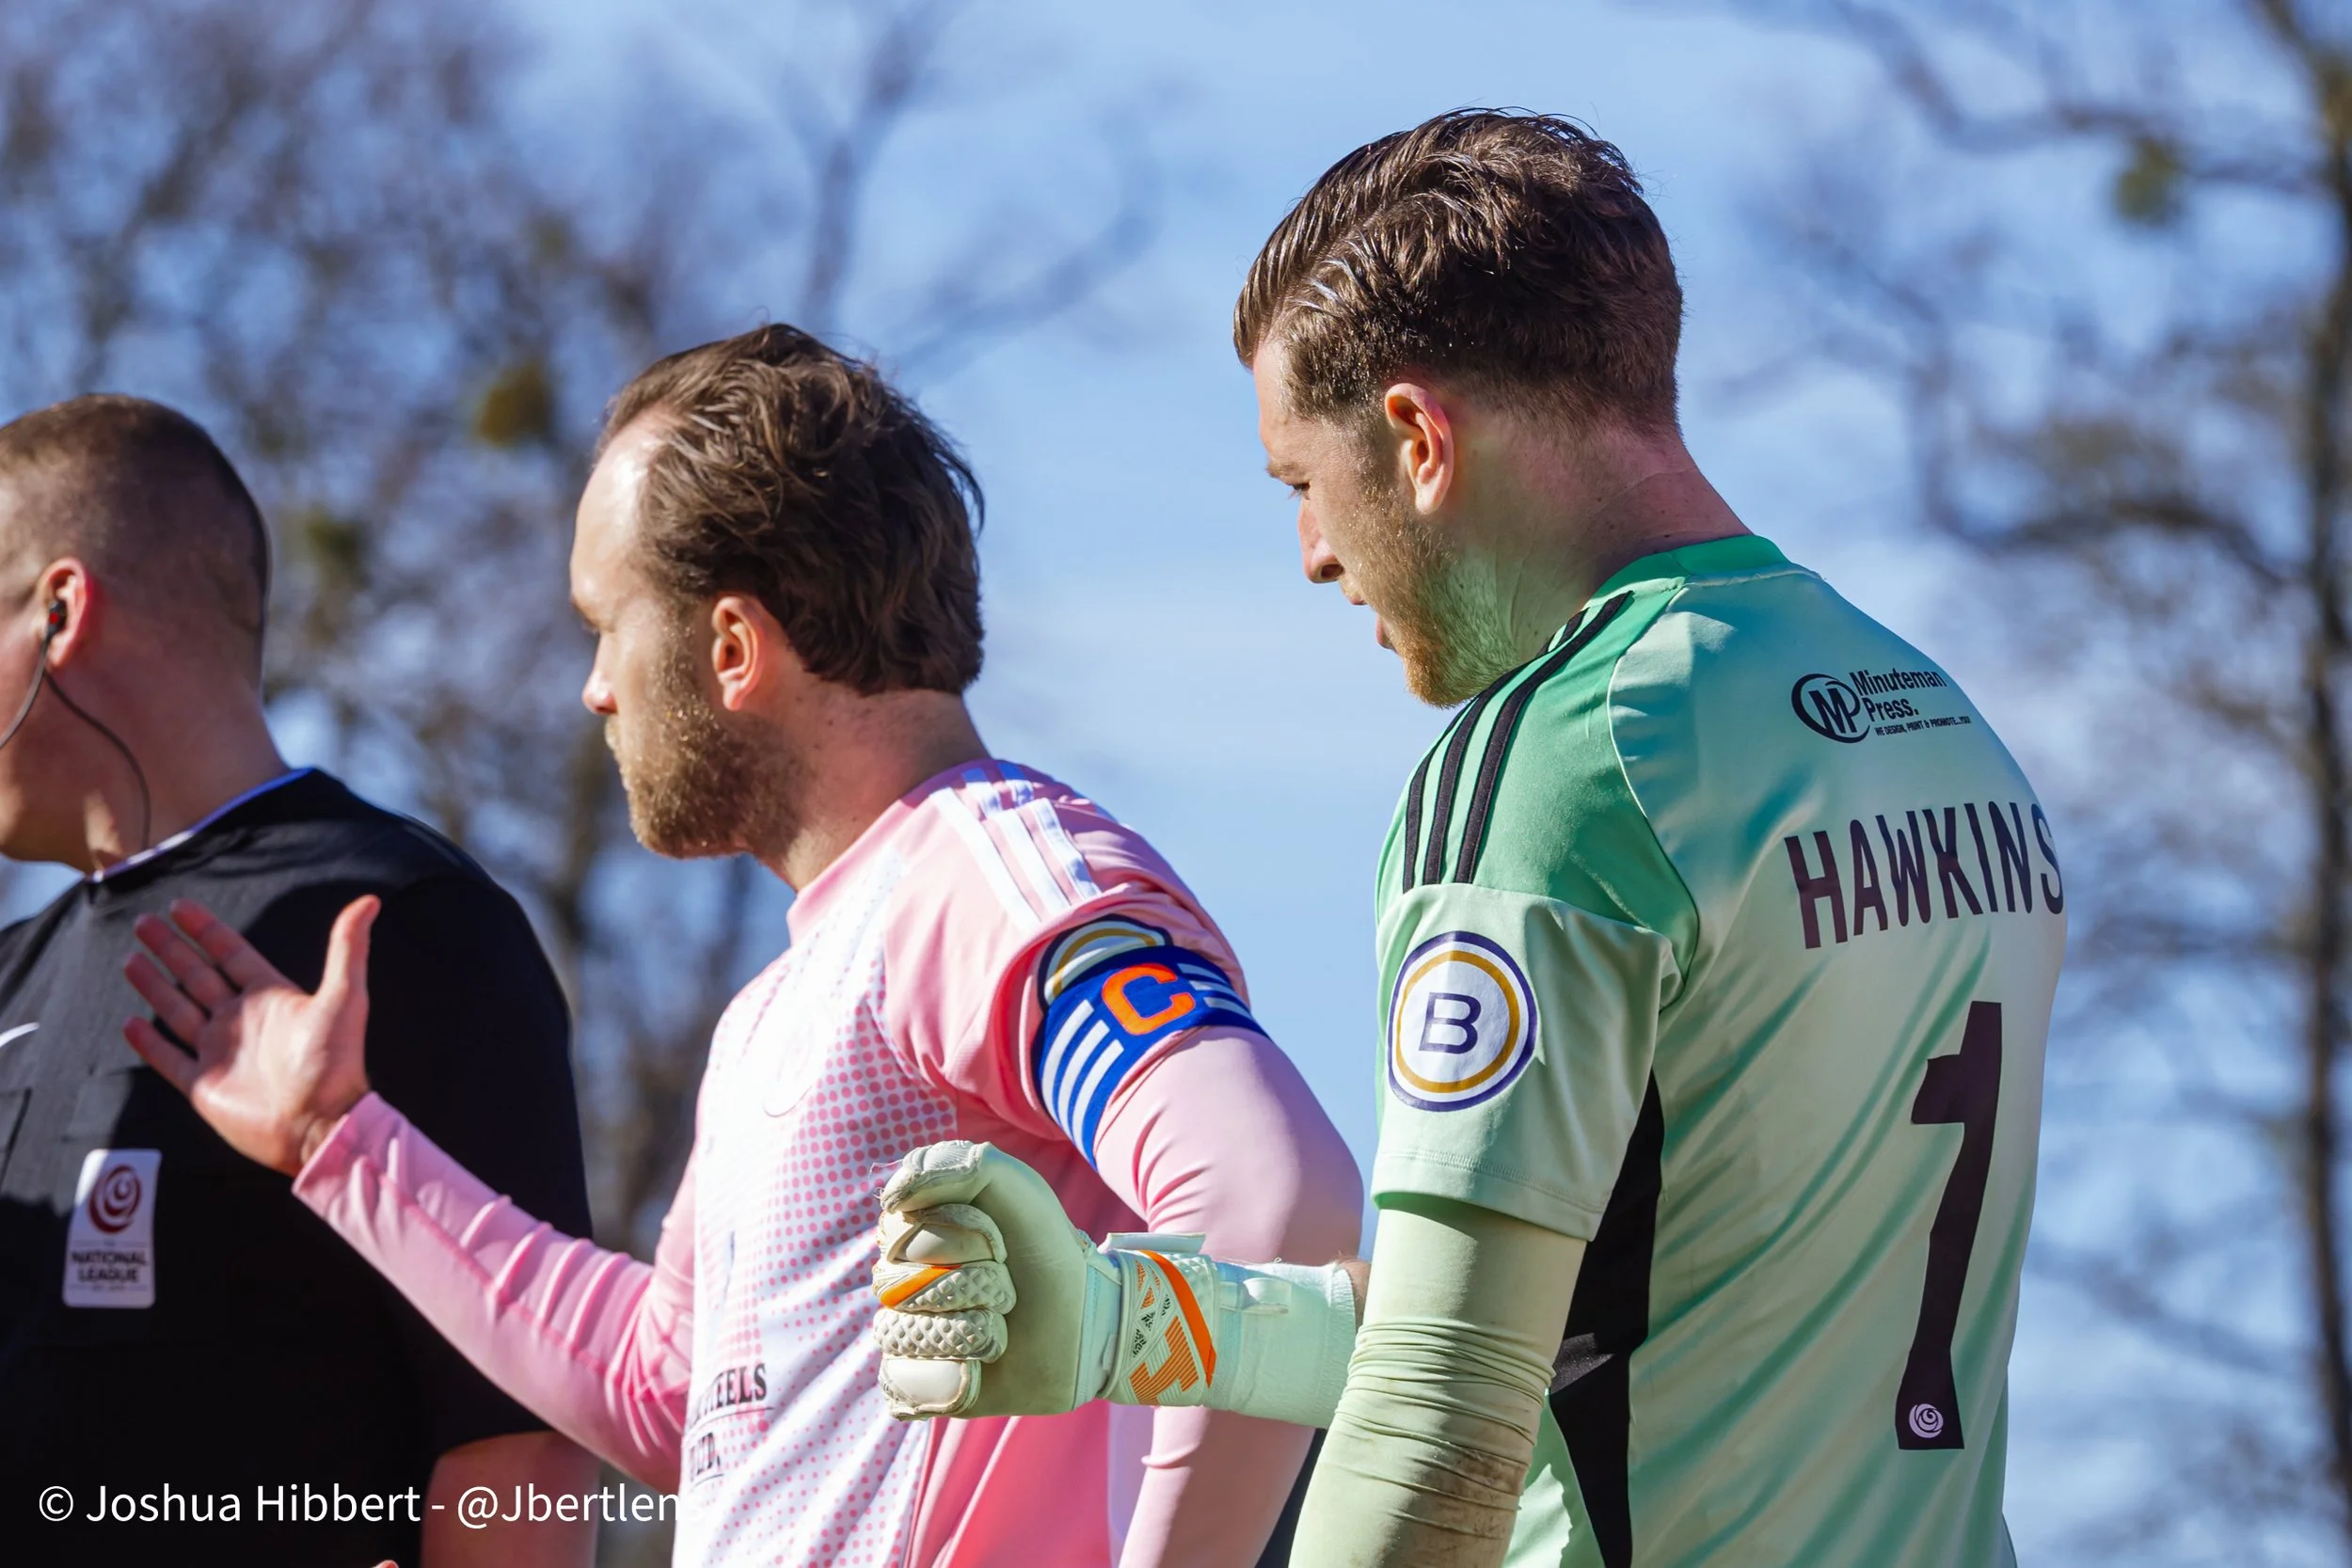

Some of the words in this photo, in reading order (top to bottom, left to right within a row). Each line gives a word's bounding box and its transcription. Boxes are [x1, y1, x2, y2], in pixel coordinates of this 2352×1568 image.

[1849, 668, 1947, 697] Minuteman
[1861, 697, 1920, 722] Press.
[1874, 726, 1884, 736] WE
[1784, 800, 2064, 950] HAWKINS
[1102, 962, 1196, 1036] C
[1418, 991, 1482, 1054] B
[1895, 1000, 2002, 1449] 1
[72, 1250, 147, 1266] NATIONAL
[78, 1267, 139, 1283] LEAGUE
